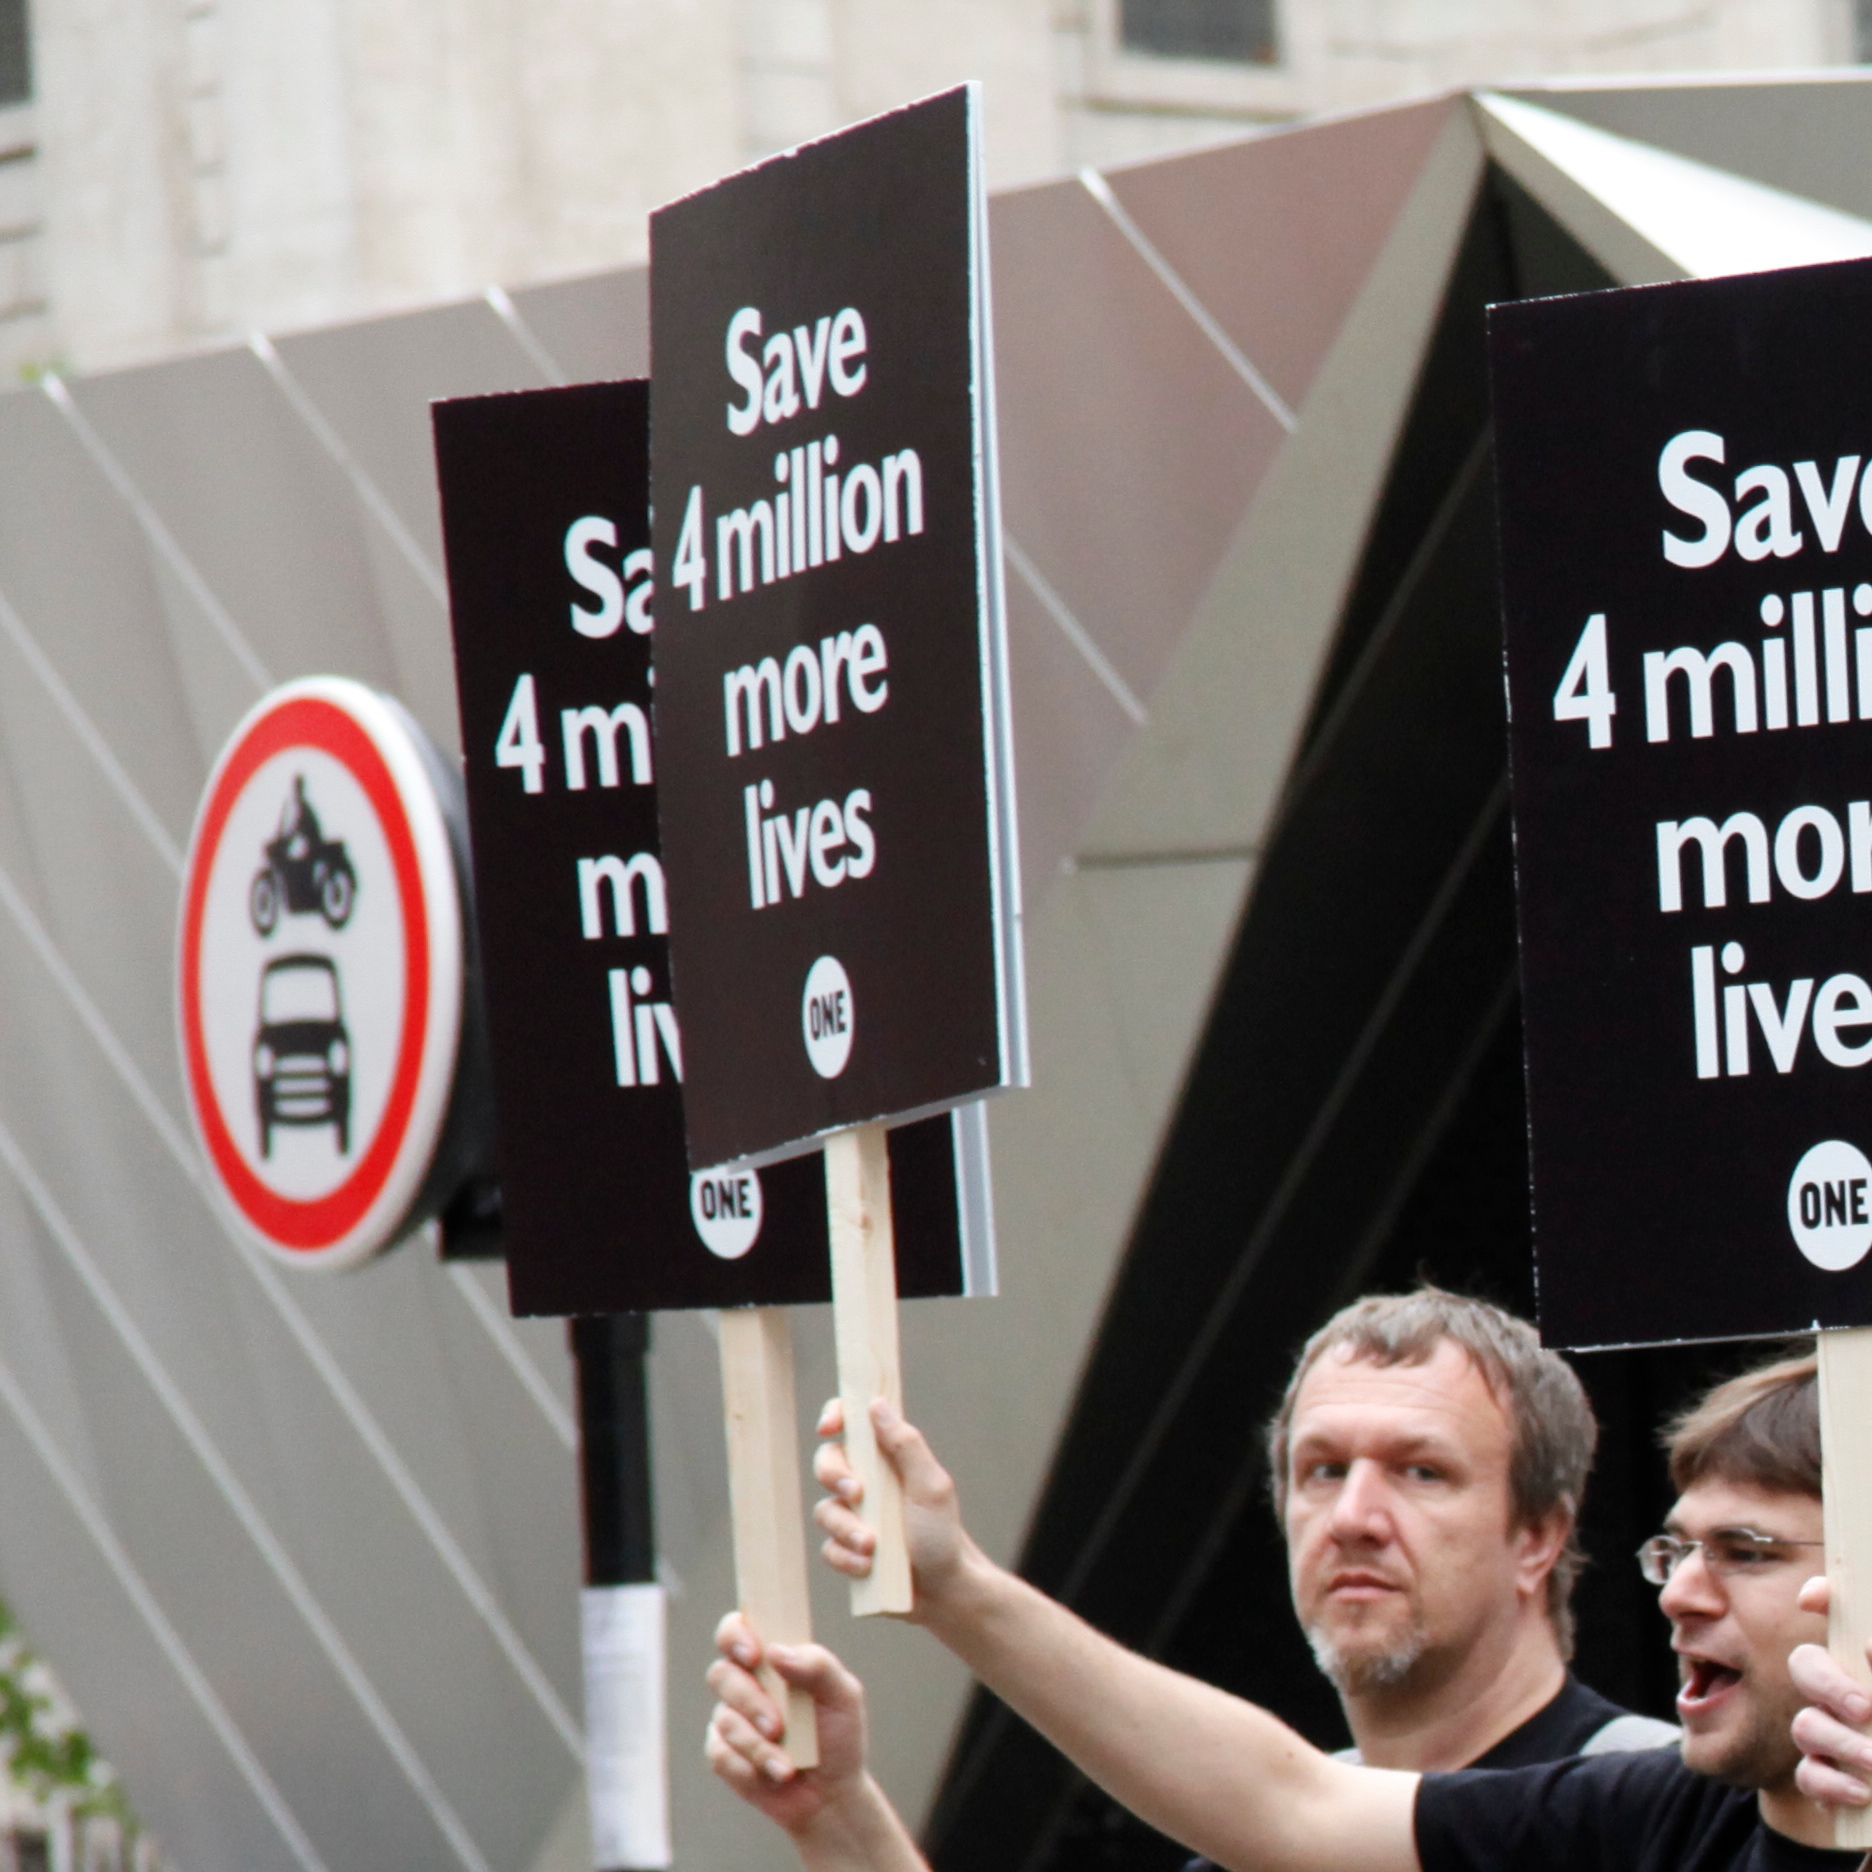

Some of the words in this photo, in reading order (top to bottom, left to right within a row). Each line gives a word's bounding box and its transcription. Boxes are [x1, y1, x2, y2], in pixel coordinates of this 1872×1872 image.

[726, 307, 866, 436] Save
[566, 516, 653, 638] Sa
[673, 486, 706, 611] 4
[717, 439, 923, 600] million
[496, 675, 544, 793] 4
[724, 624, 887, 756] more
[1553, 614, 1615, 748] 4
[745, 780, 875, 909] lives
[810, 990, 846, 1040] ONE
[701, 1179, 751, 1219] ONE
[1800, 1178, 1869, 1229] ONE
